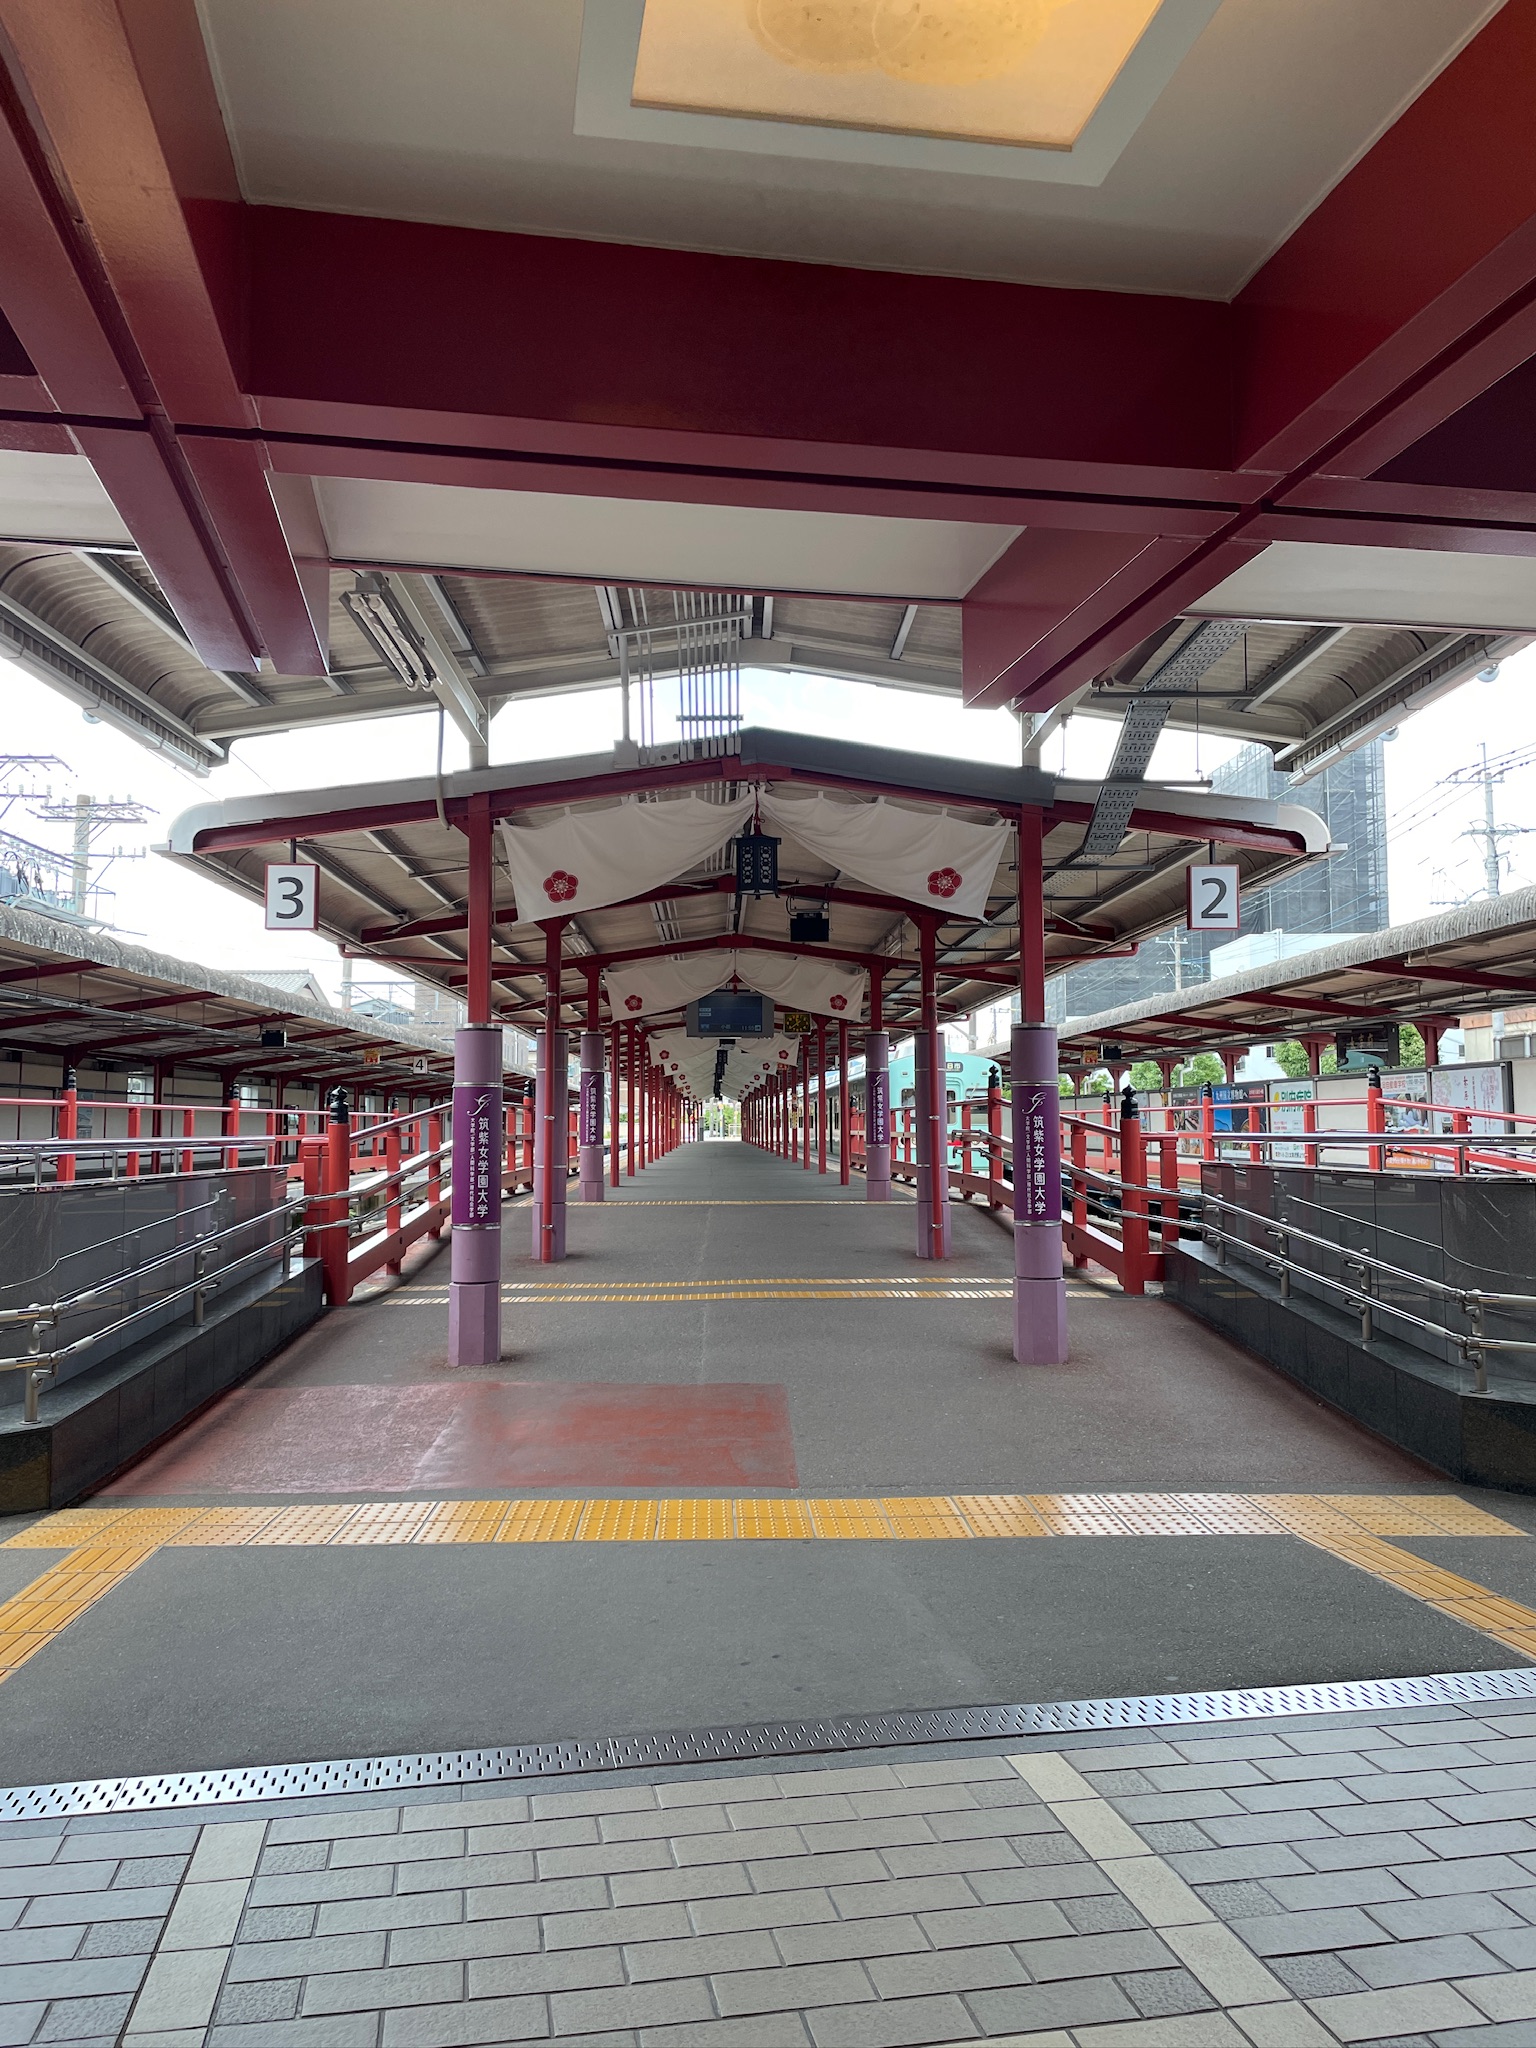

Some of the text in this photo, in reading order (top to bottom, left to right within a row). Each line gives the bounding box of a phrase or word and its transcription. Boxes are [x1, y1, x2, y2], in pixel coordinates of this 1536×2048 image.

[275, 876, 304, 919] 3
[1200, 877, 1229, 919] 2
[415, 1058, 424, 1071] 4
[477, 1117, 490, 1219] 筑紫女学園大学
[1033, 1115, 1046, 1215] 筑紫女学園大学
